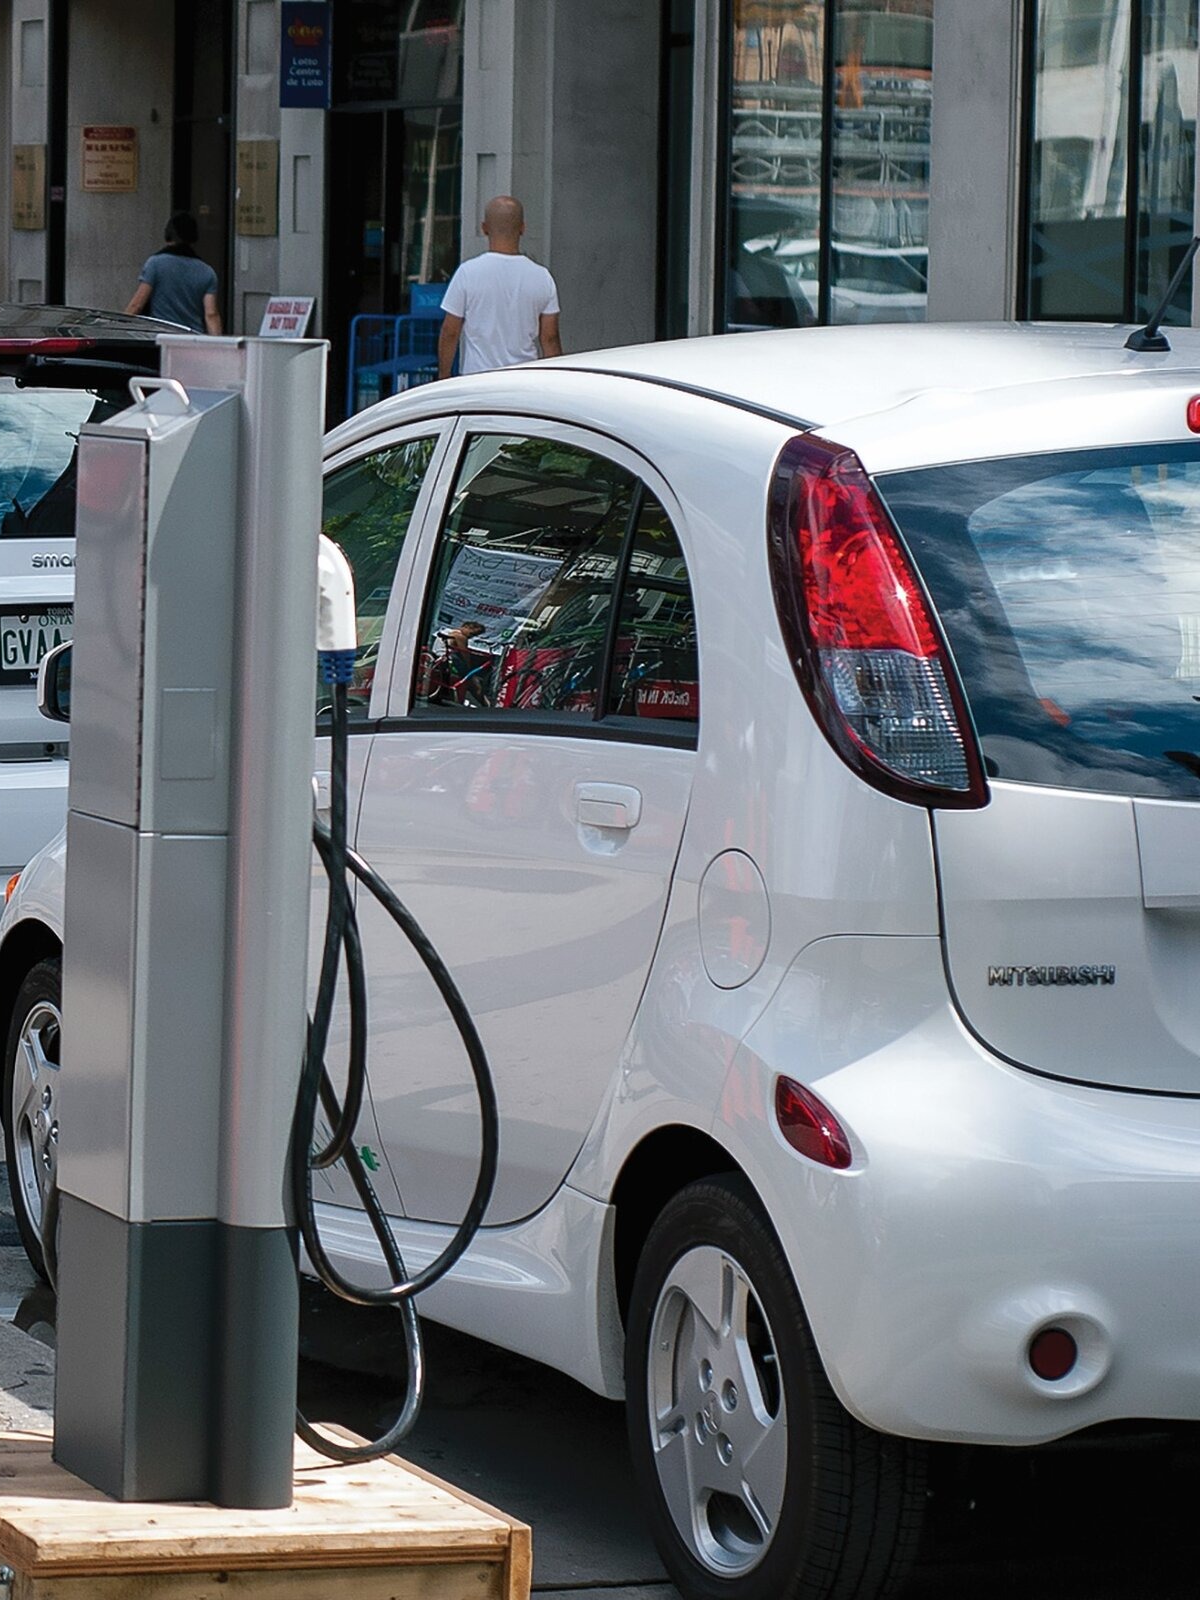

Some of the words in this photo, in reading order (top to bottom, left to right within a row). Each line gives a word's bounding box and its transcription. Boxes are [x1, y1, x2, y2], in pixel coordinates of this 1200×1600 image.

[292, 57, 318, 66] Lotto
[289, 67, 321, 76] Centre
[301, 79, 324, 87] Loto
[31, 553, 77, 569] sma
[46, 607, 74, 616] TORON
[38, 615, 73, 628] ONTA
[2, 628, 63, 665] GVAA
[988, 965, 1116, 987] MITSUBISHI
